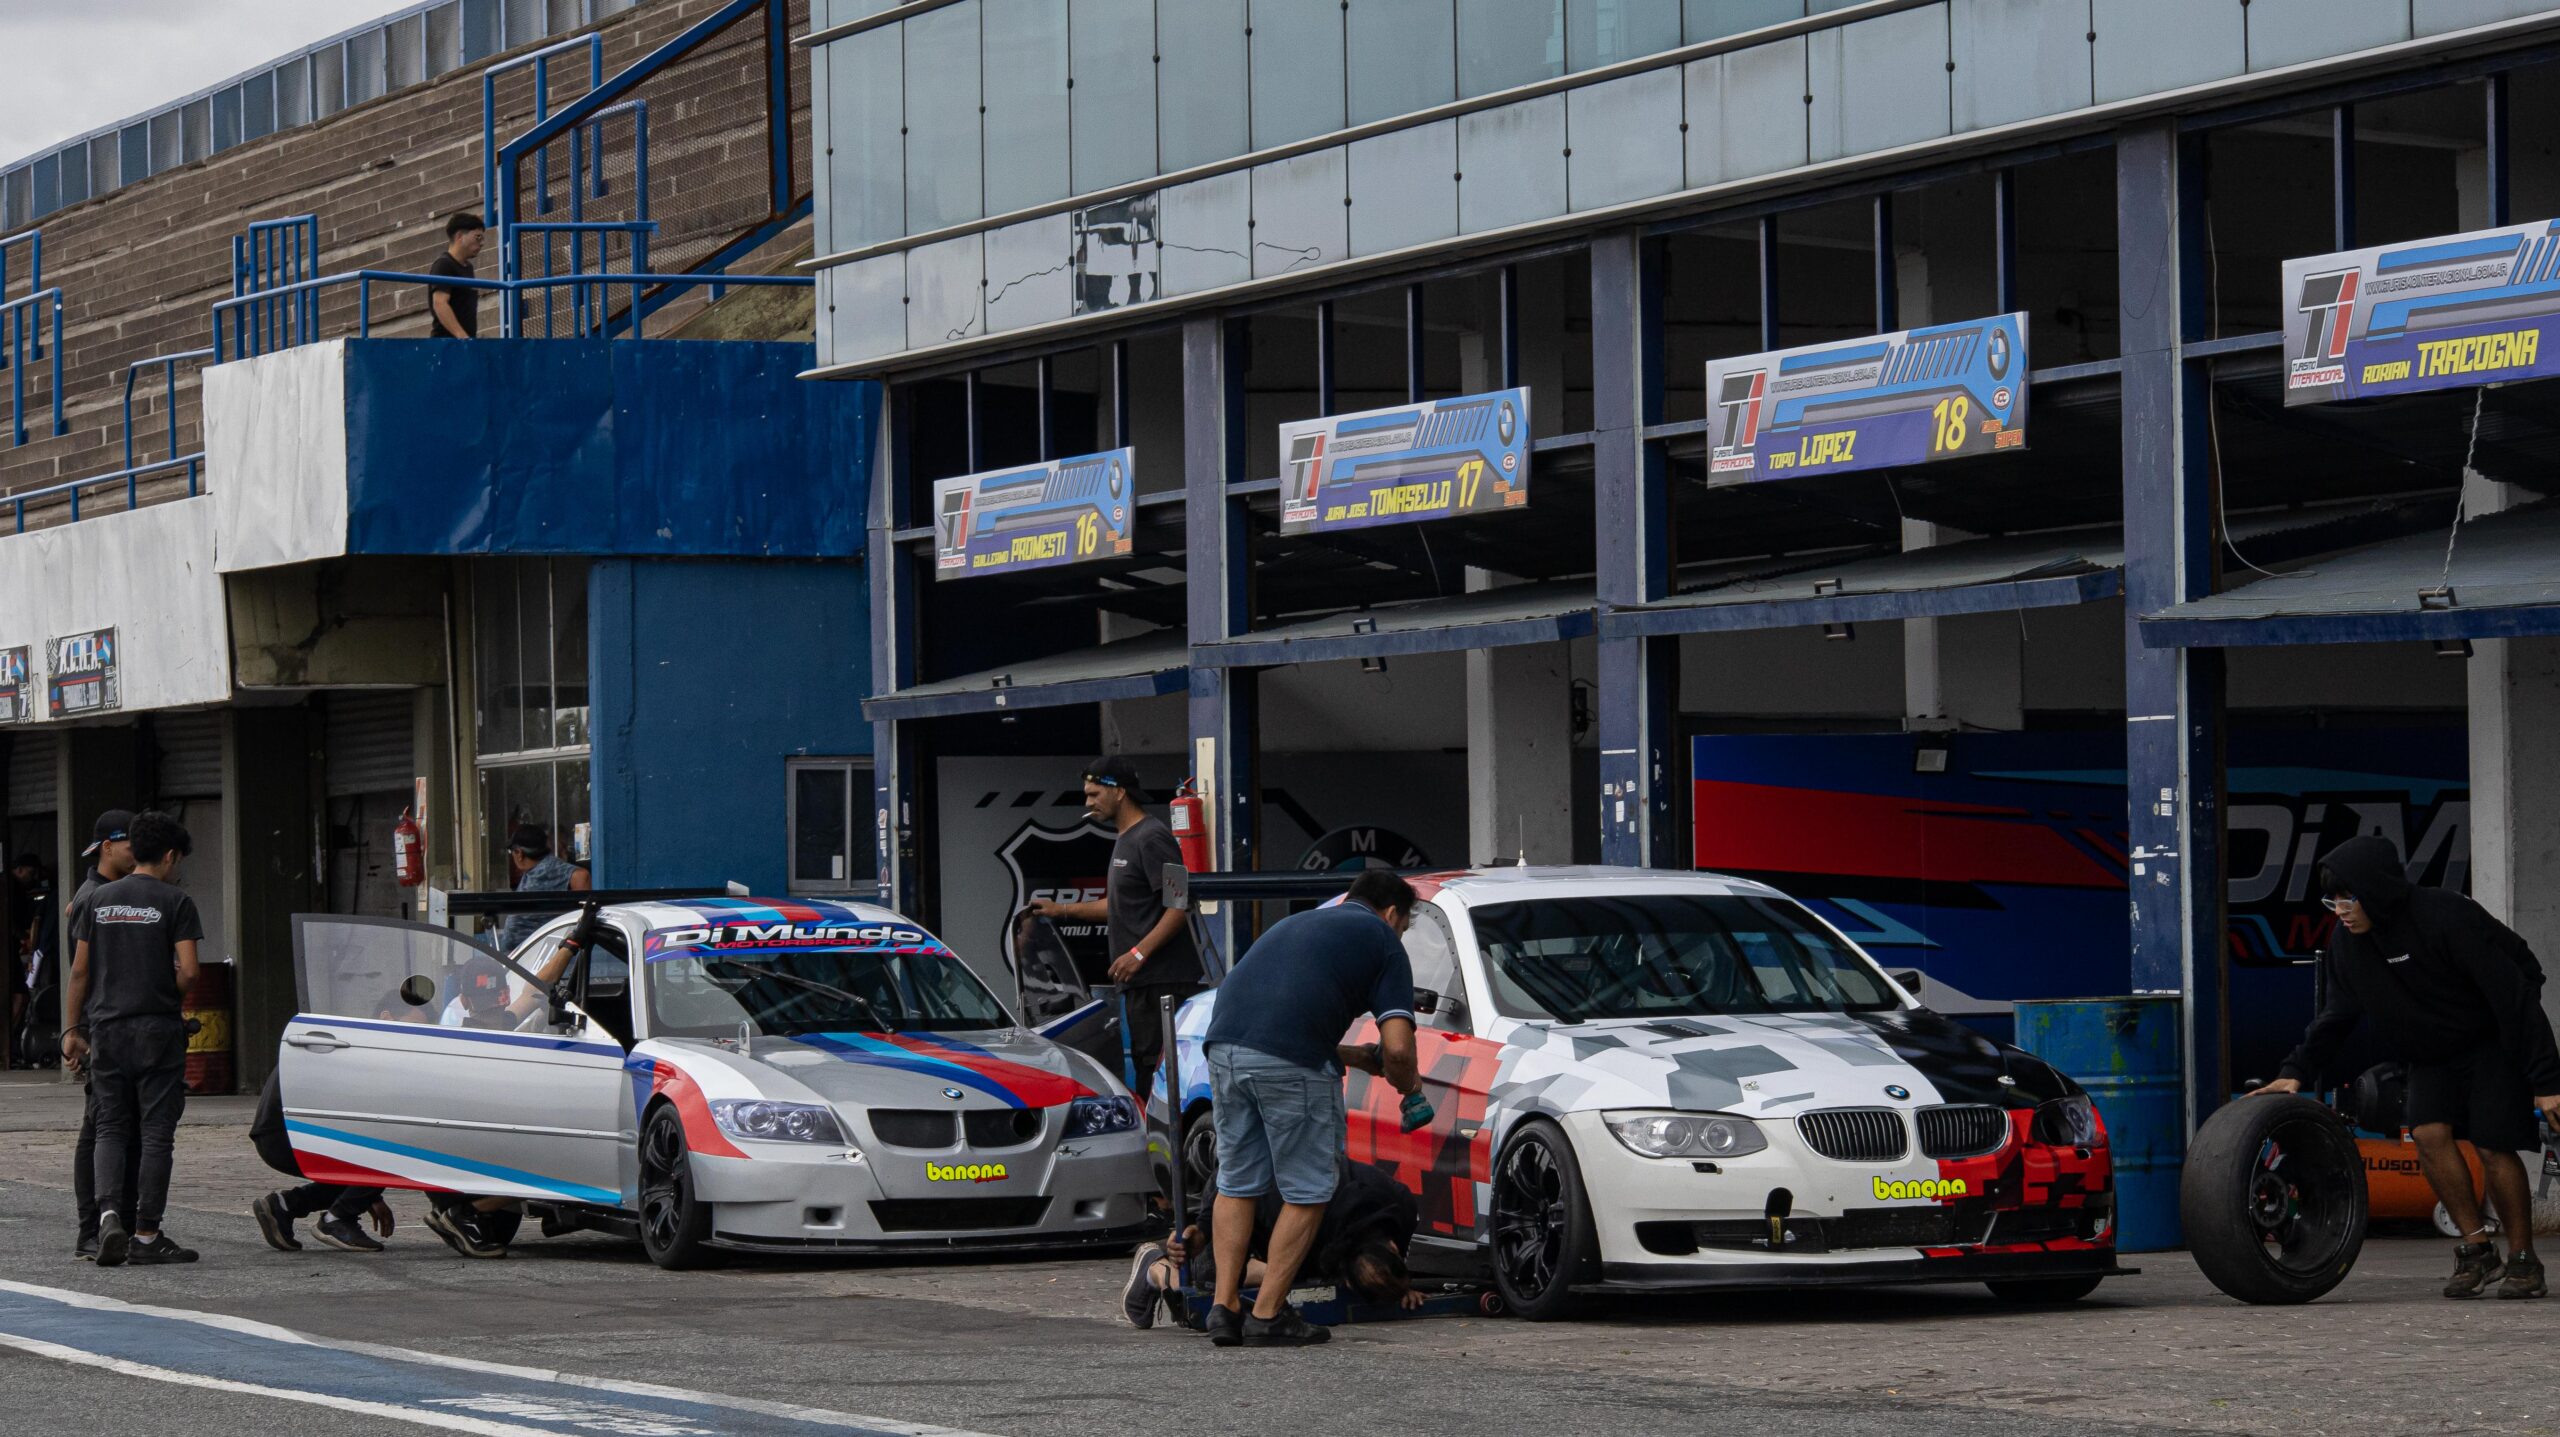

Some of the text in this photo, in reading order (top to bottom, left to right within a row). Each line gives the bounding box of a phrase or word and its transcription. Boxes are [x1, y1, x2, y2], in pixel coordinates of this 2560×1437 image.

[2362, 328, 2540, 385] ADRIAN TRACOGNA
[1932, 395, 1969, 452] 18
[1769, 430, 1857, 470] TOPO LOPEZ
[1324, 480, 1452, 522] JUAN JOSE TOMASELLO
[1457, 459, 1485, 509] 17
[1076, 511, 1099, 556] 16
[2343, 800, 2470, 892] M
[112, 905, 162, 919] Mundo
[1031, 887, 1106, 904] SPE
[660, 924, 924, 947] Di Mundo
[714, 939, 876, 949] MOTORSPORT
[1872, 1175, 1967, 1201] banana
